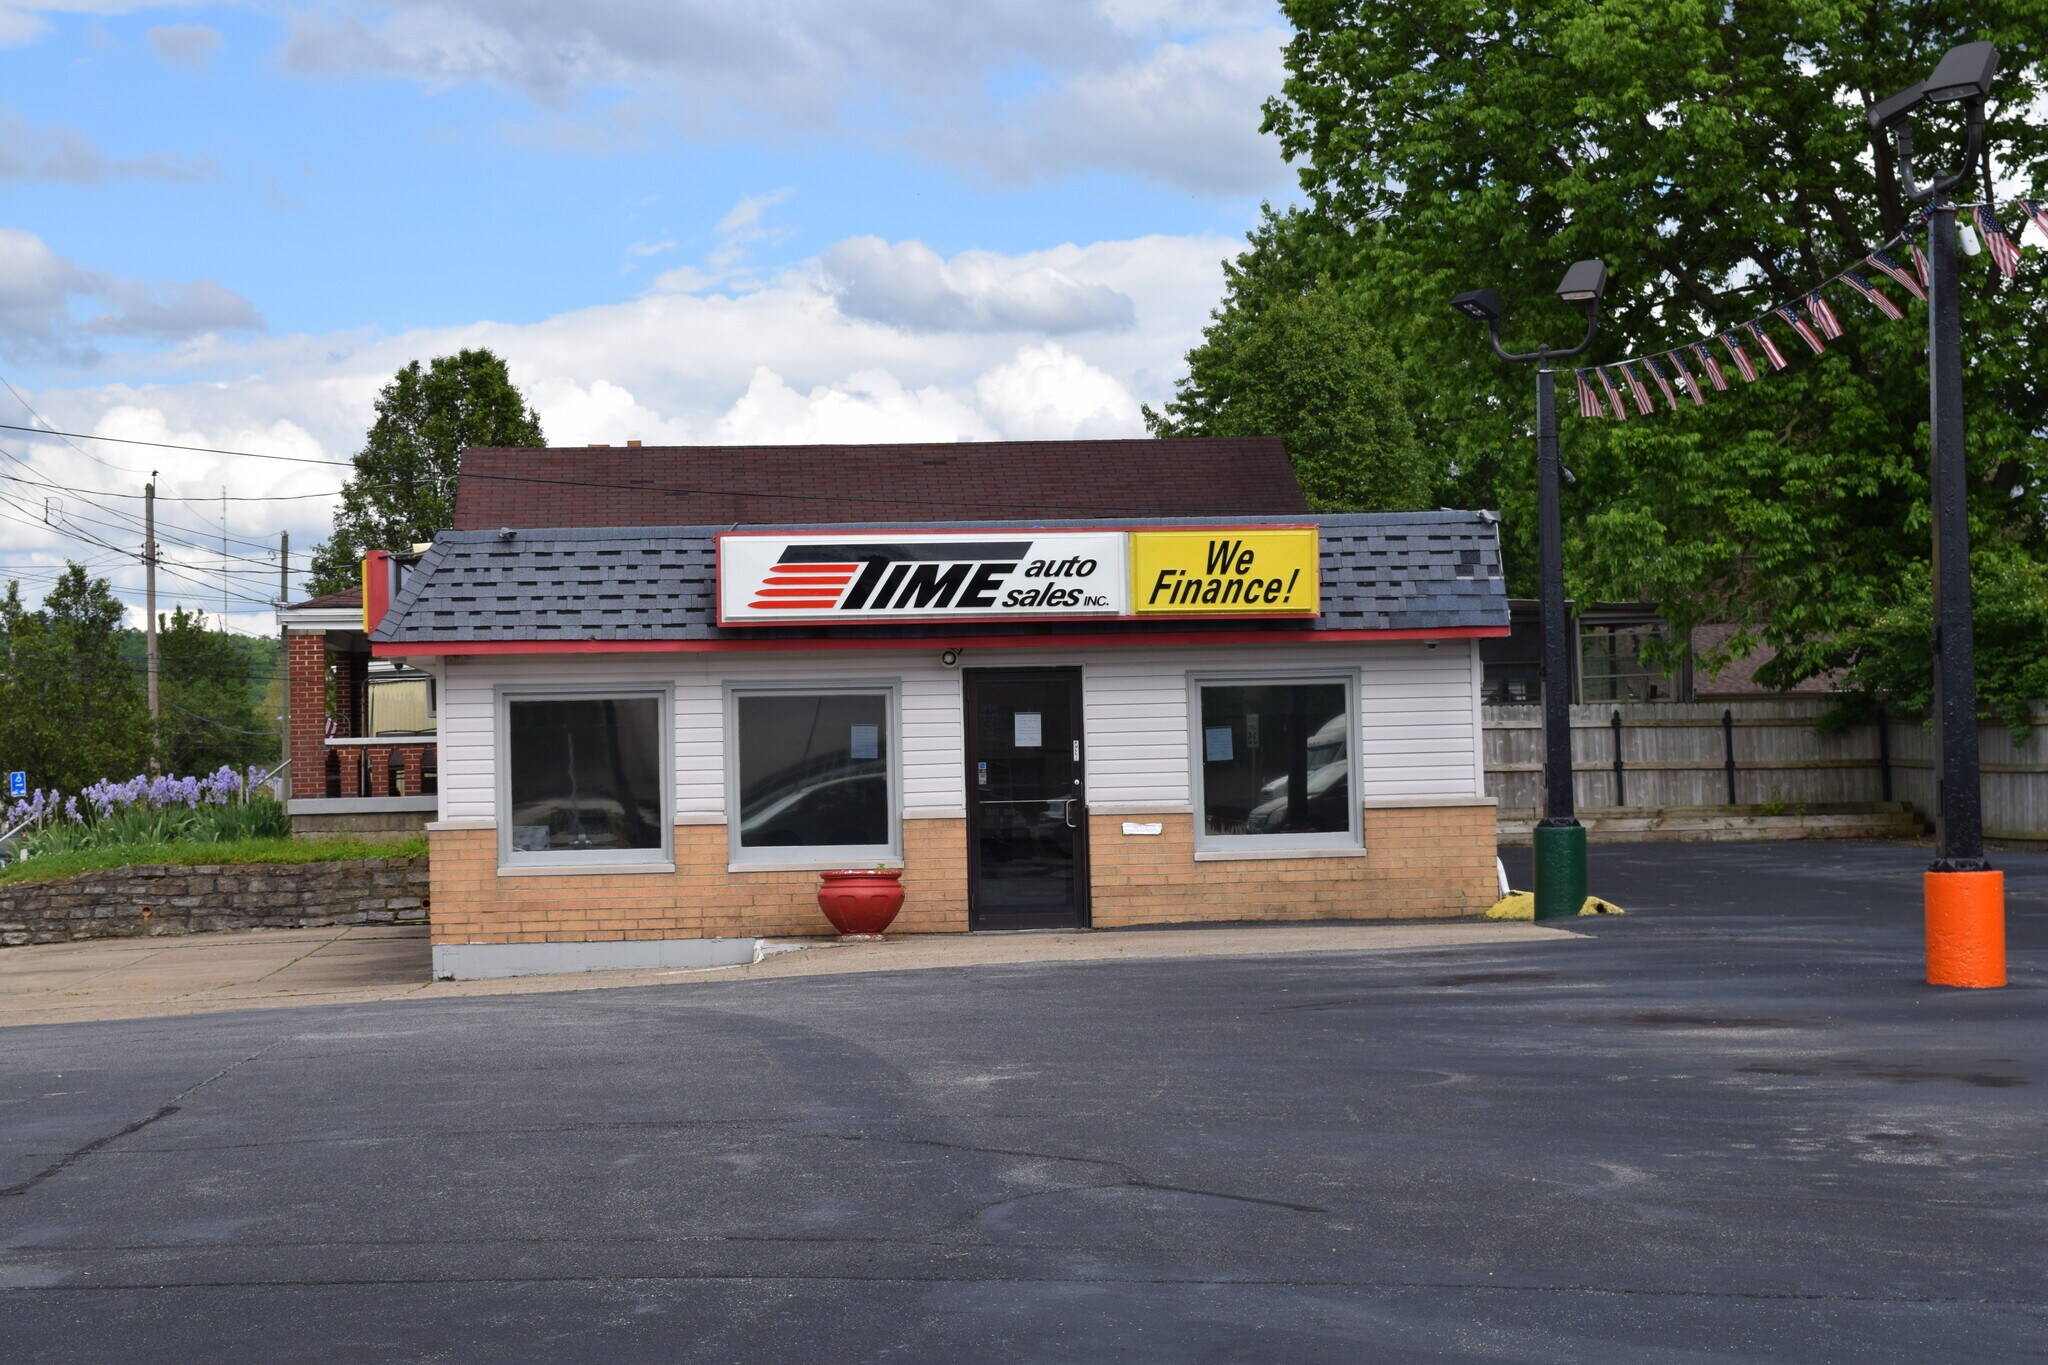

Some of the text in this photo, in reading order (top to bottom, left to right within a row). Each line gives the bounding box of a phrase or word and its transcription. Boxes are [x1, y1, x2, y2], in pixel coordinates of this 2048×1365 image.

[1024, 555, 1098, 577] auto
[1206, 540, 1255, 575] We
[1002, 588, 1109, 608] sales INC.
[1148, 569, 1300, 605] Finance!
